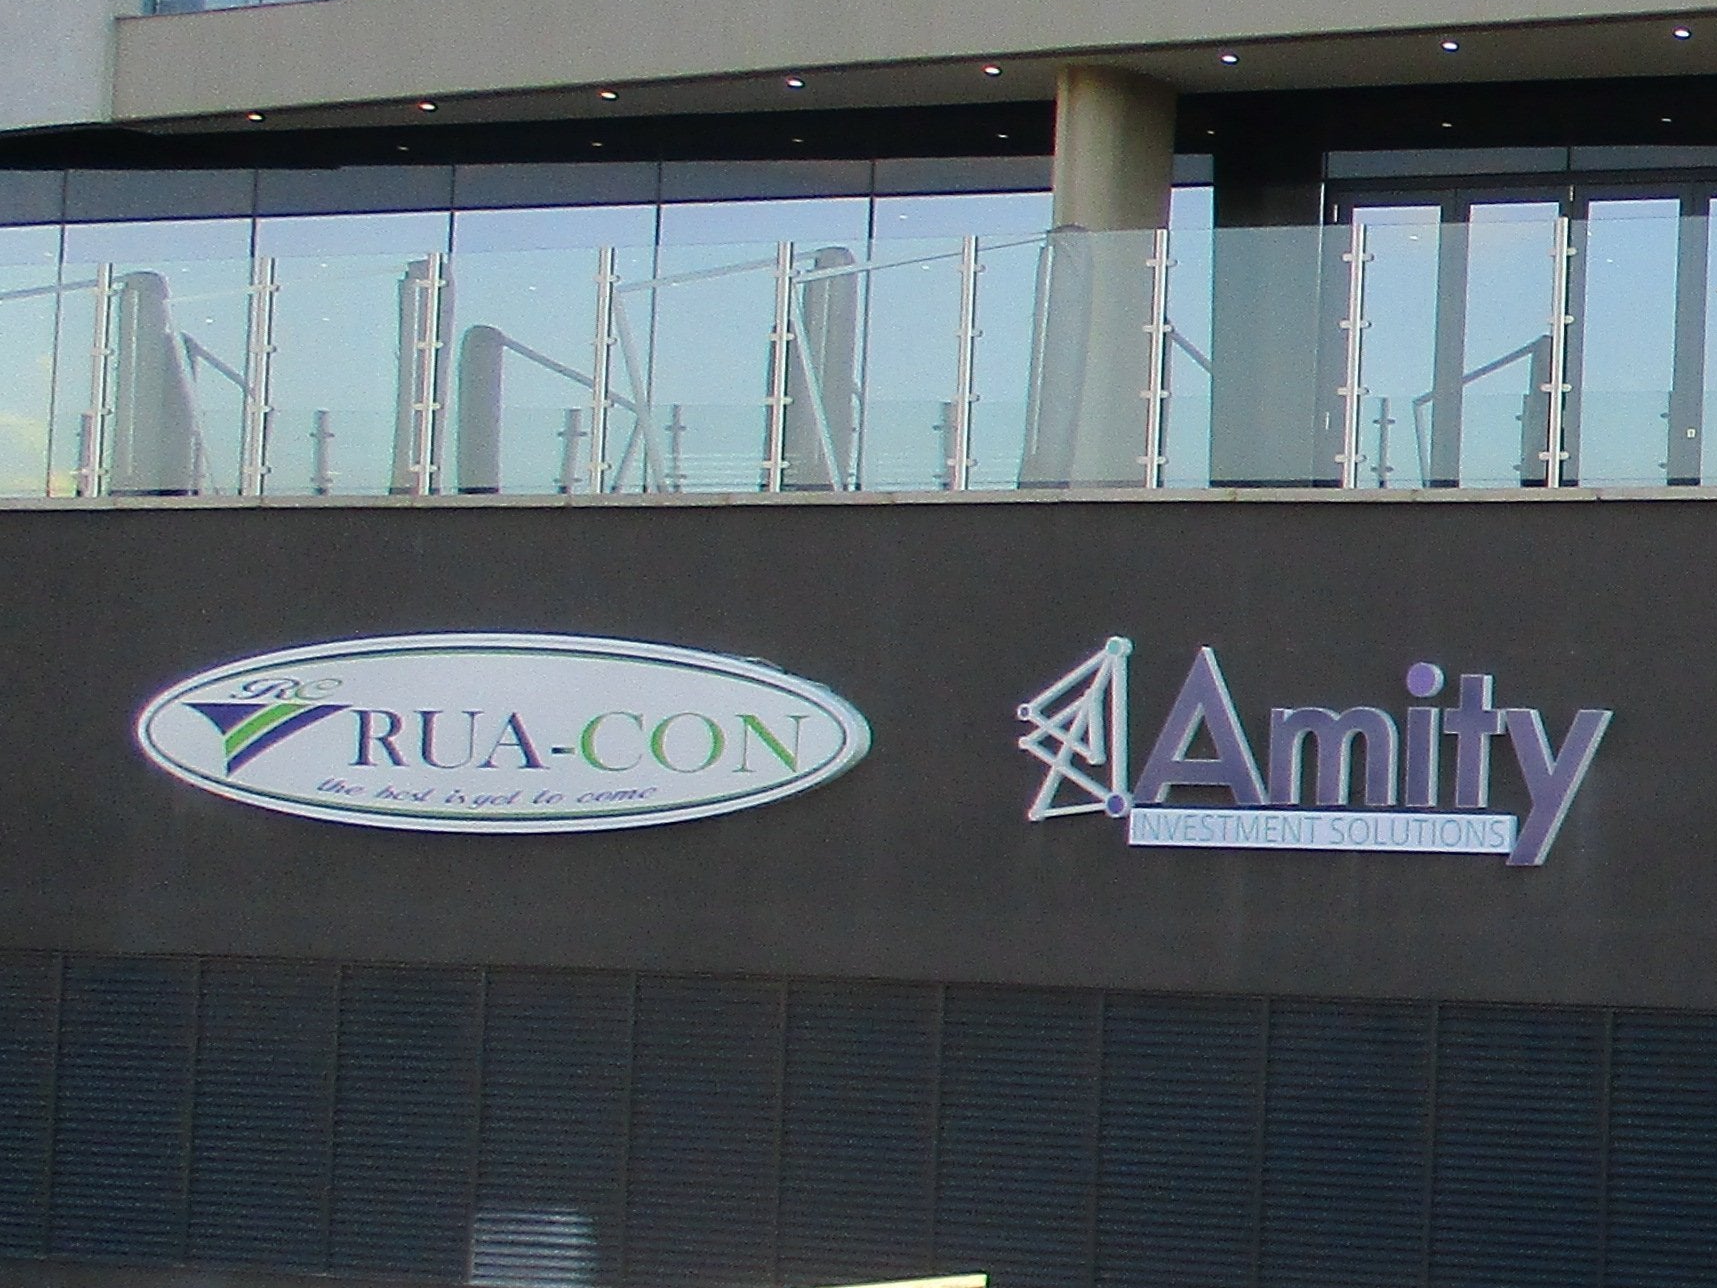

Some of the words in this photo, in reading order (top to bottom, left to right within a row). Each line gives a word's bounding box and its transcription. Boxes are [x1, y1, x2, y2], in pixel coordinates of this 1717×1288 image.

[347, 708, 809, 774] RUA-CON
[1133, 645, 1613, 865] Amity
[316, 777, 364, 795] the
[532, 788, 565, 805] to
[576, 786, 656, 804] come
[1131, 814, 1321, 844] INVESTMENT
[1330, 817, 1510, 849] SOLUTIONS
